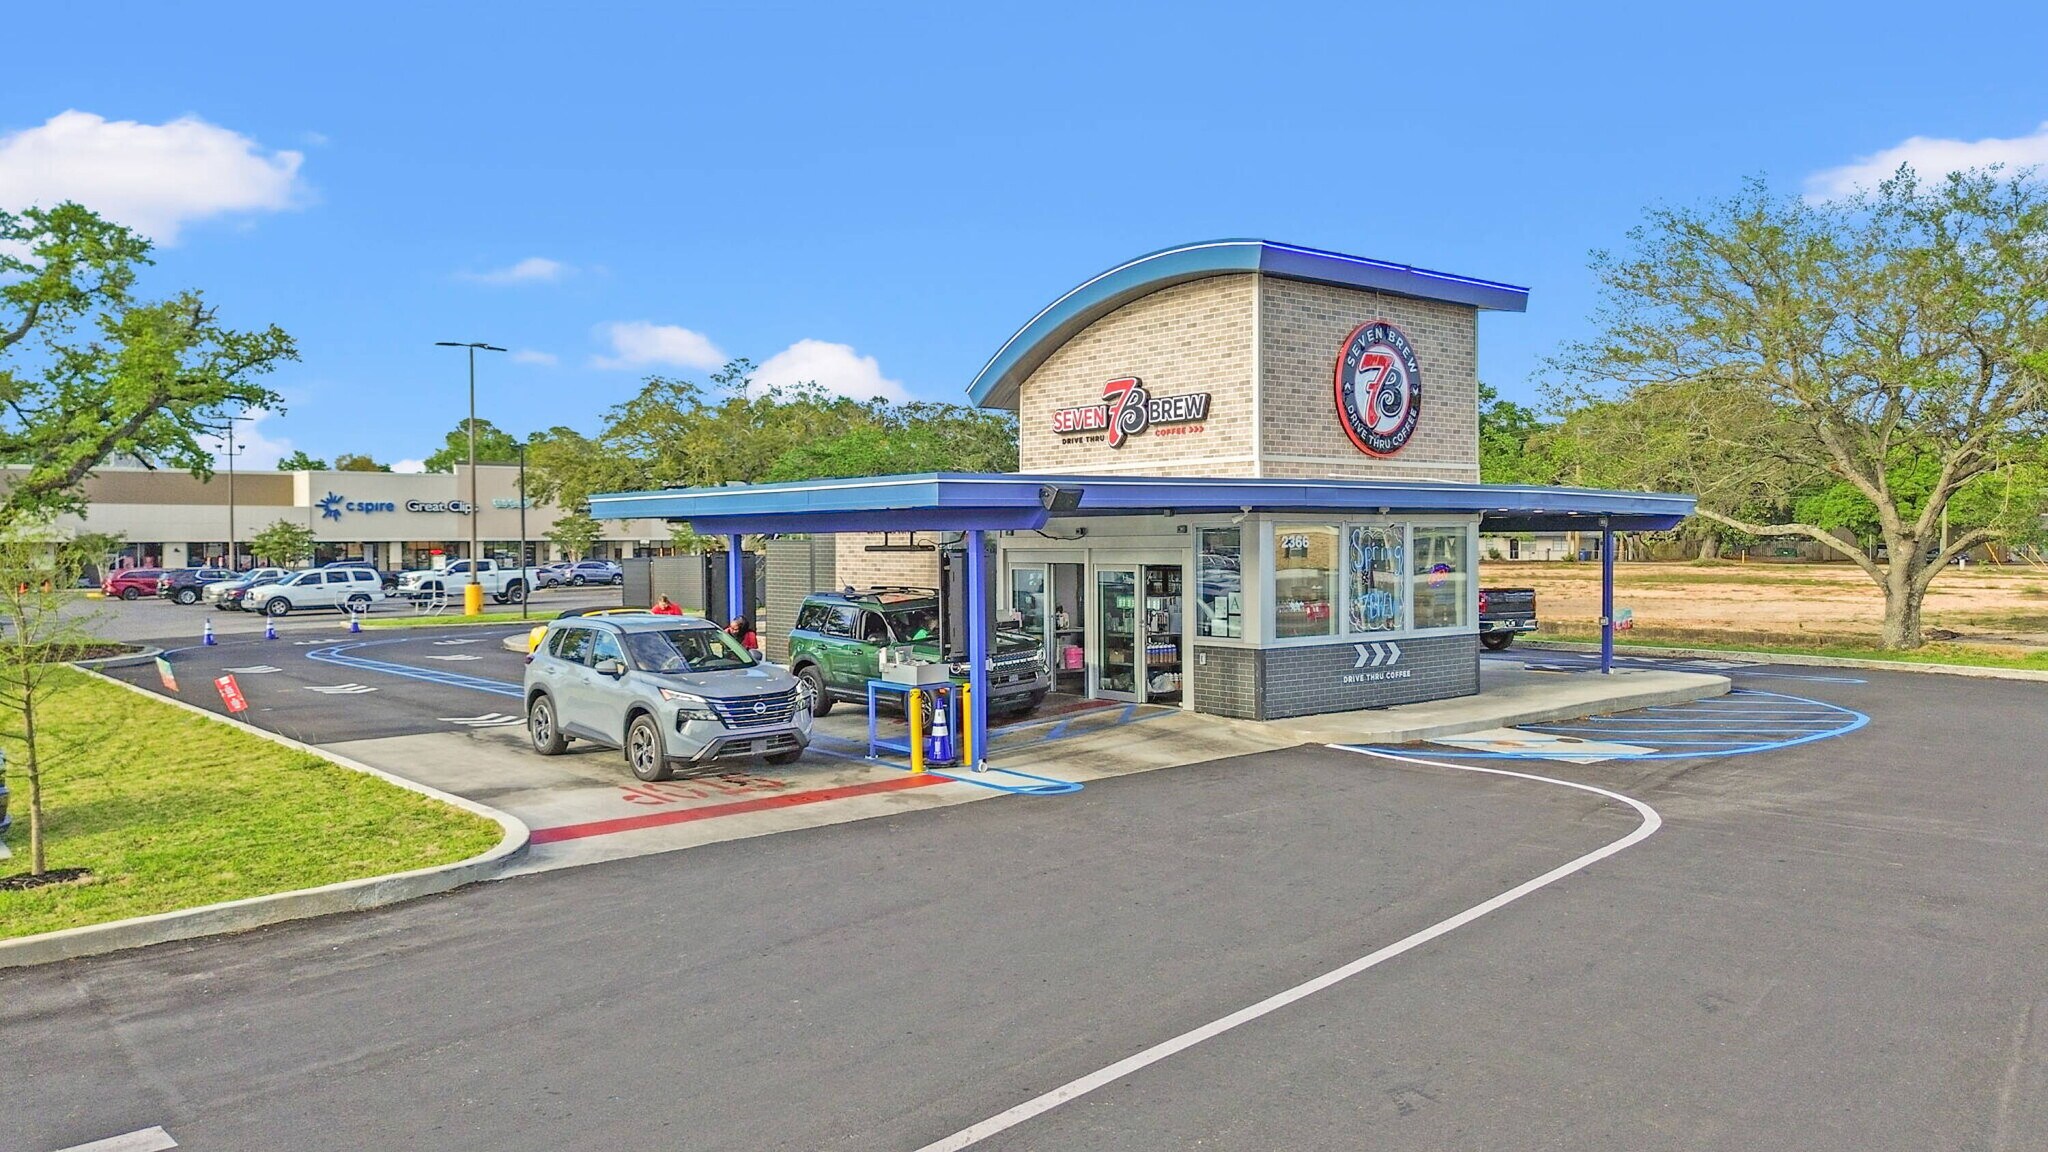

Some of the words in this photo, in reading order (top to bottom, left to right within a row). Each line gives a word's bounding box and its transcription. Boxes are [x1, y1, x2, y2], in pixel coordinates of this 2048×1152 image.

[1347, 327, 1383, 368] SEVEN
[1388, 331, 1418, 373] BREW
[1053, 408, 1106, 432] SEVEN
[1150, 395, 1206, 422] BREW
[1155, 427, 1186, 436] COFFEE
[1347, 404, 1367, 440] DRIVE
[1368, 434, 1391, 449] THRU
[1392, 407, 1418, 446] COFFEE
[1062, 436, 1083, 445] DRIVE
[1086, 435, 1105, 443] THRU
[357, 501, 394, 514] spire
[406, 499, 446, 513] Great
[1281, 535, 1310, 548] 2366
[1351, 529, 1403, 575] Spring
[1230, 596, 1240, 610] A
[1343, 675, 1364, 683] DRIVE
[1366, 673, 1384, 682] THRU
[1386, 670, 1411, 679] COFFEE
